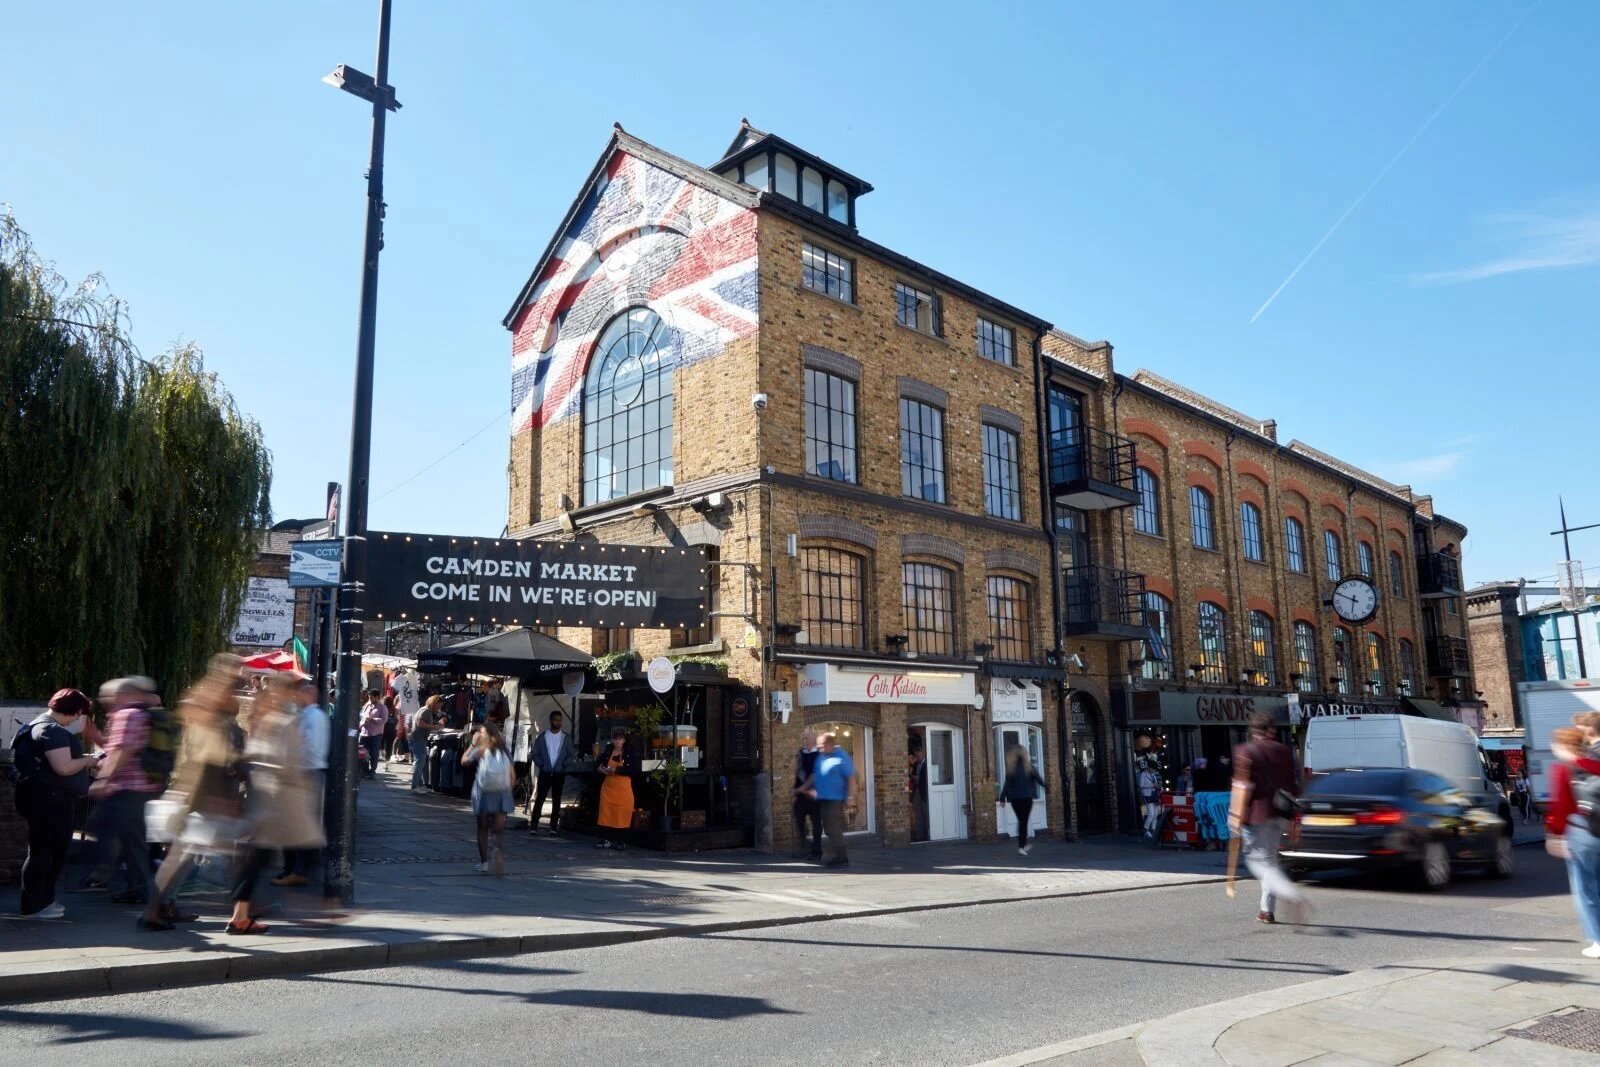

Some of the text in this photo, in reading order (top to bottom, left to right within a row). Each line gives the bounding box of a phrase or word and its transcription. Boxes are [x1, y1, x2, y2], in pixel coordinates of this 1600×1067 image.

[315, 548, 340, 557] CCTV
[426, 557, 636, 582] CAMDEN MARKET
[411, 582, 481, 601] COME
[489, 585, 512, 602] IN
[520, 586, 586, 605] WE'RE
[239, 609, 285, 617] NGWALLS
[261, 632, 276, 641] LOFT
[540, 663, 568, 671] CAMDEN
[866, 674, 928, 699] Cath Kidston
[993, 708, 1021, 719] KOMONO
[1196, 695, 1256, 721] GANDYS
